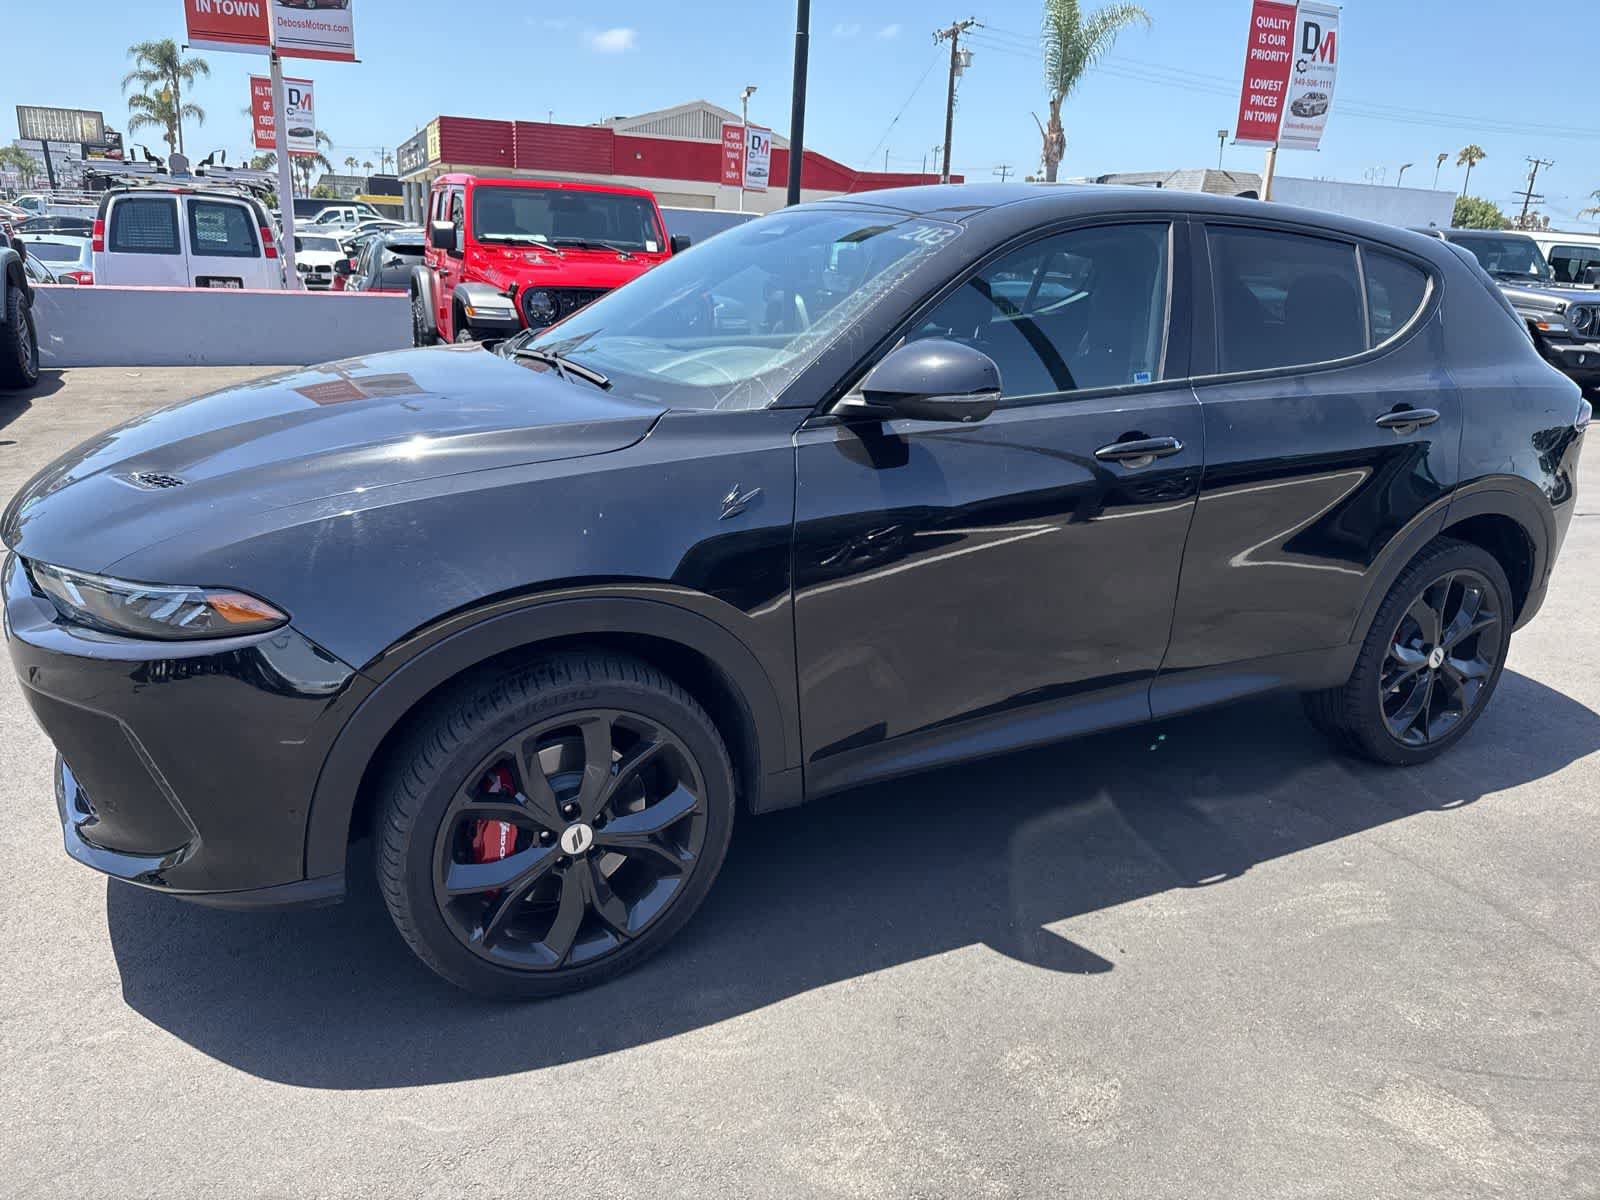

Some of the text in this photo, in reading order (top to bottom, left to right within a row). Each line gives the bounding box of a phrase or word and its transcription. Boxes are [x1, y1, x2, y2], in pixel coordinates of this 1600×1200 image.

[195, 0, 260, 18] IN TOWN
[277, 16, 350, 33] DebossMotors.com
[1256, 15, 1291, 31] QUALITY
[1259, 33, 1286, 46] IS OUR
[1302, 21, 1336, 64] DM
[1250, 48, 1290, 63] PRIORITY
[255, 86, 264, 96] ALL
[1250, 78, 1283, 91] LOWEST
[263, 101, 270, 110] OF
[288, 87, 312, 111] DM
[1250, 95, 1278, 108] PRICES
[1244, 110, 1278, 123] IN TOWN
[257, 129, 276, 139] WELCO
[727, 131, 740, 140] CARS
[724, 142, 742, 150] TRUCKS
[727, 151, 739, 160] VANS
